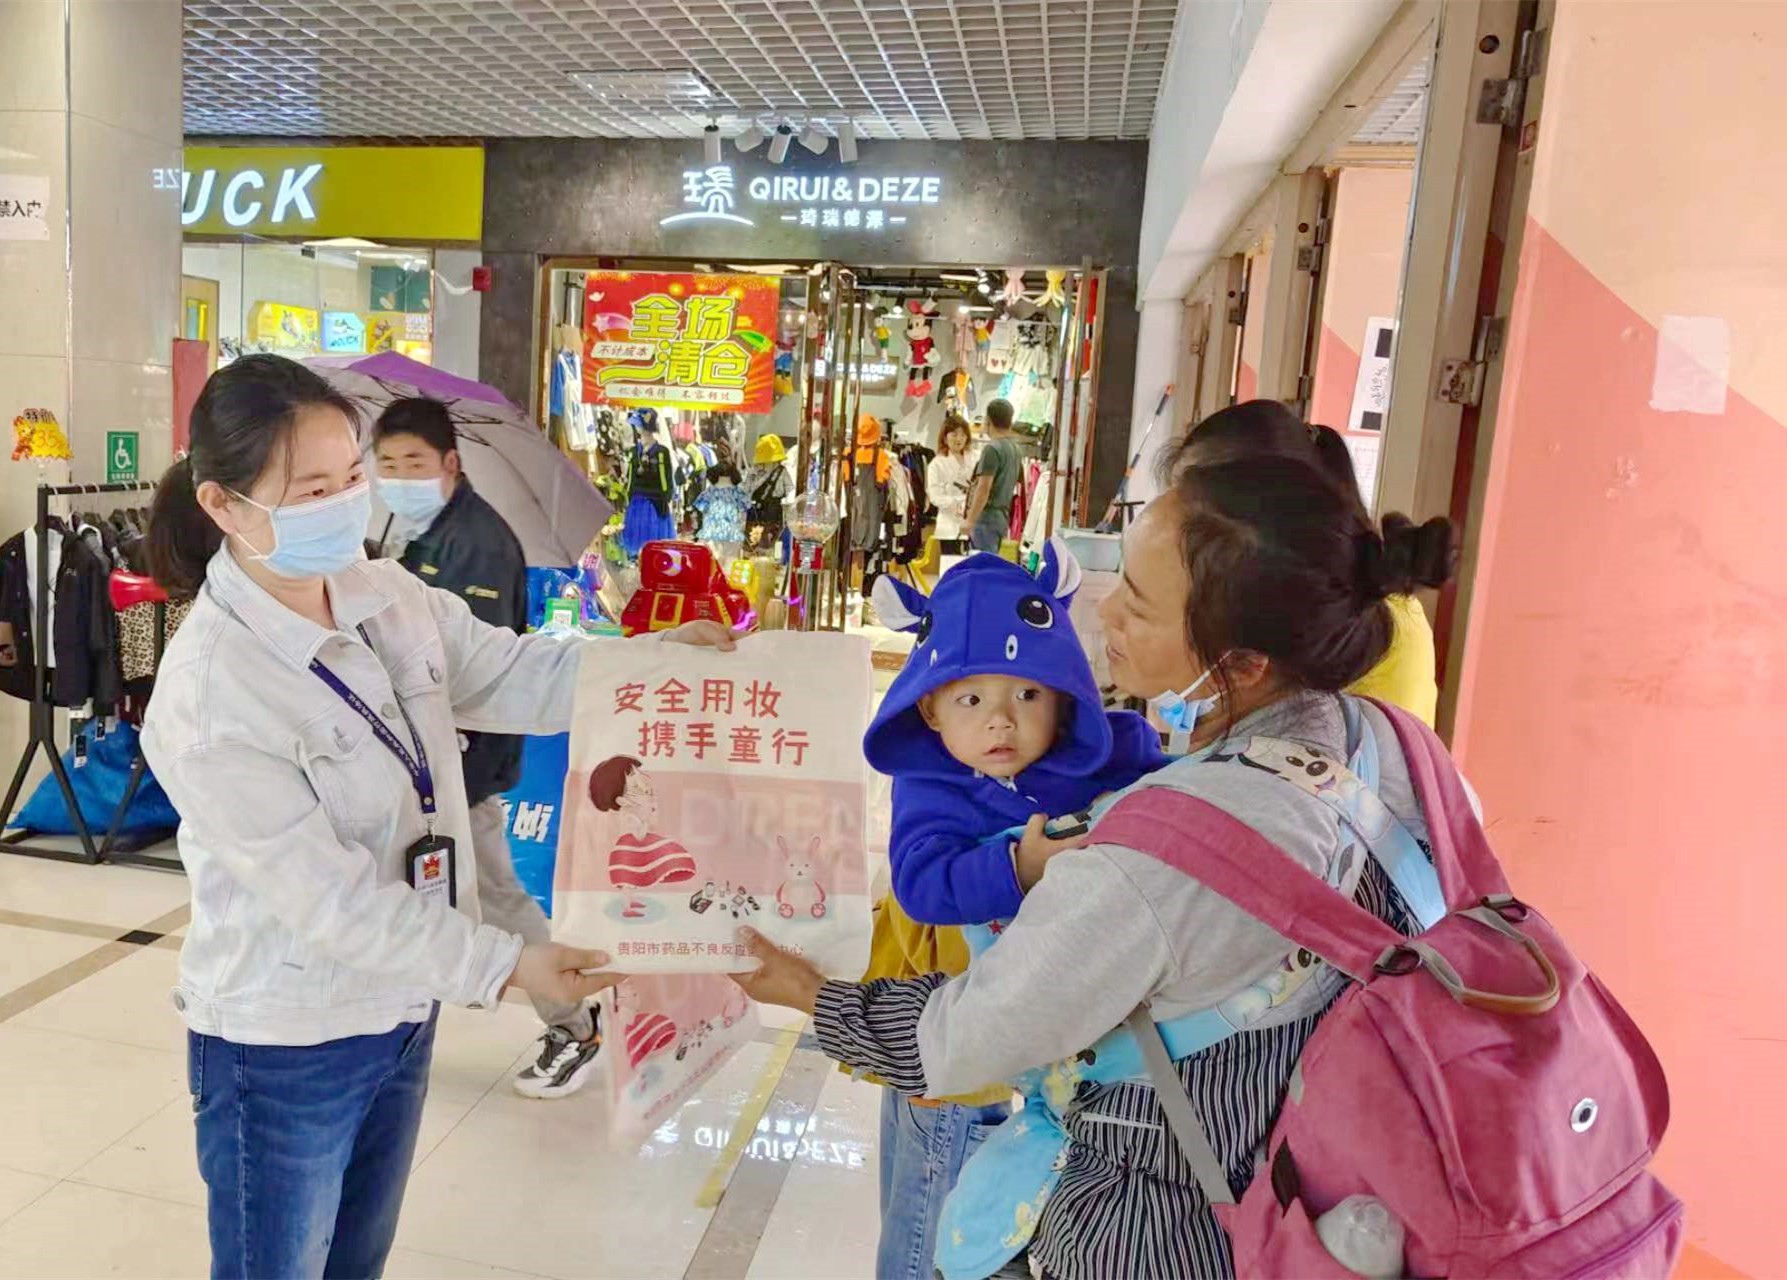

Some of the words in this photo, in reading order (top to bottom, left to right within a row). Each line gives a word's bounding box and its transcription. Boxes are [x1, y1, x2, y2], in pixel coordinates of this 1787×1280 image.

[750, 177, 940, 202] QIRUI&DEZE
[629, 293, 736, 342] 全场
[597, 339, 752, 387] 清仓
[614, 677, 782, 718] 安全用妆
[637, 720, 810, 766] 携手童行
[618, 941, 804, 957] 贵阳市药品不良反应中心
